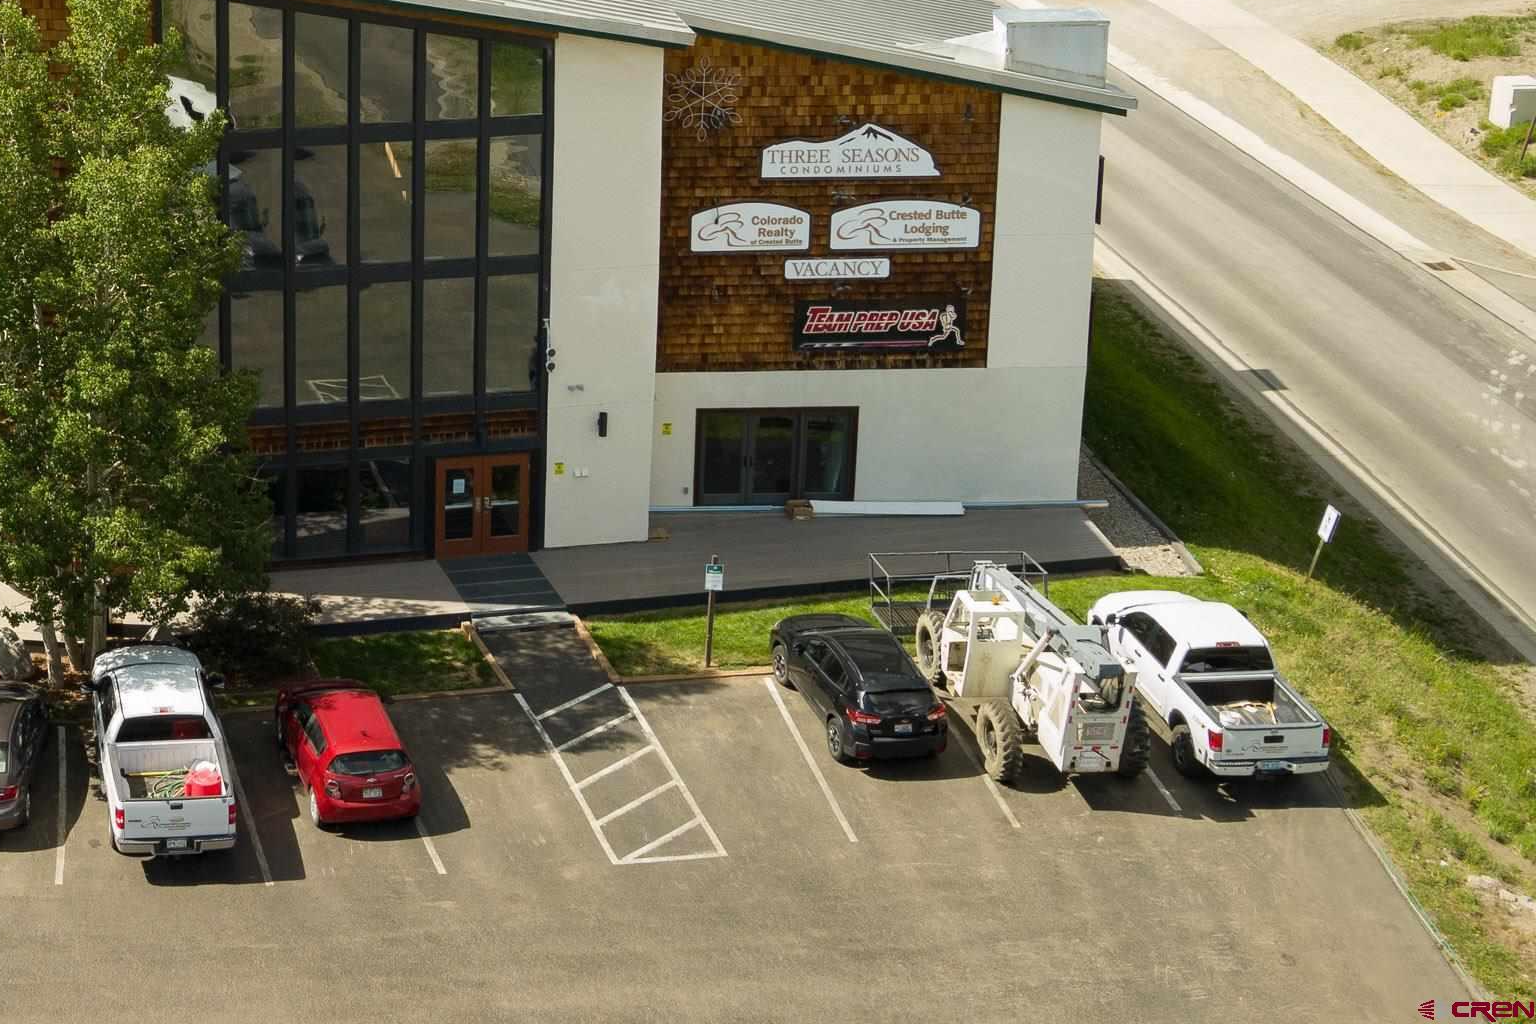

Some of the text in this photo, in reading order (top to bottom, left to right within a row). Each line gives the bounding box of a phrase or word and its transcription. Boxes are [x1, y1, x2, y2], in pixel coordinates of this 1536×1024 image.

[767, 147, 920, 164] THREE SEASONS
[780, 164, 902, 175] CONDOMINIUMS
[751, 215, 803, 226] Colorado
[889, 209, 967, 221] Crested Butte
[758, 227, 796, 238] Realty
[904, 223, 949, 236] Lodging
[792, 261, 884, 276] VACANCY
[803, 306, 939, 333] TEAM PREP USA
